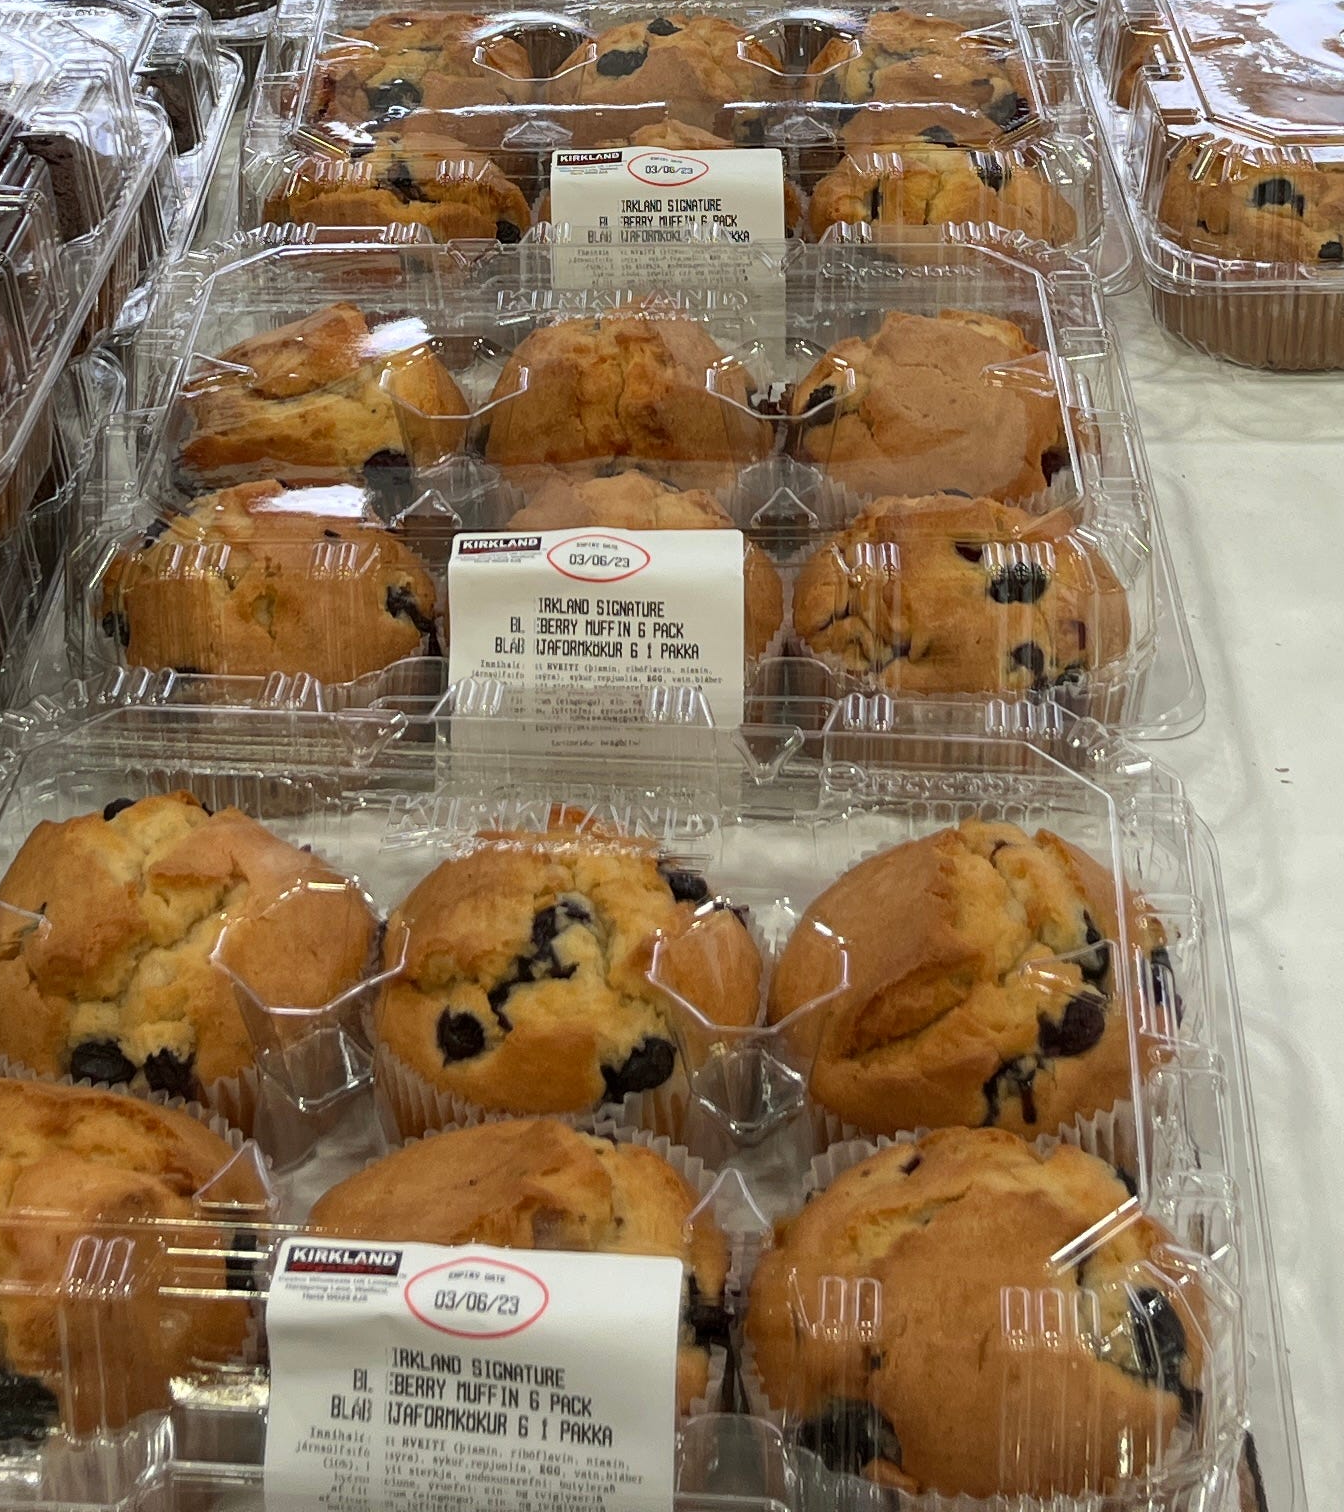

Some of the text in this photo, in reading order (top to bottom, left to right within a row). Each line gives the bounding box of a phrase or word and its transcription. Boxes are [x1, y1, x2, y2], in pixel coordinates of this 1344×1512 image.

[559, 152, 620, 163] KIRKLAND
[667, 199, 722, 212] SIGNATURE
[462, 537, 538, 550] KIRKLAND
[569, 553, 630, 569] 03/06/23
[596, 599, 666, 619] SIGNATURE
[585, 620, 631, 638] MUFFIN
[638, 622, 646, 638] 6
[653, 622, 684, 639] PACK
[630, 642, 639, 658] 6
[660, 642, 699, 660] PAKKA
[292, 1247, 397, 1266] KIRKLAND
[433, 1289, 521, 1316] 03/06/23
[472, 1356, 566, 1388] SIGNATURE
[456, 1380, 520, 1409] MUFFIN
[529, 1389, 540, 1412] 6
[550, 1393, 592, 1417] PACK
[518, 1415, 529, 1438] 6
[559, 1420, 613, 1448] PAKKA
